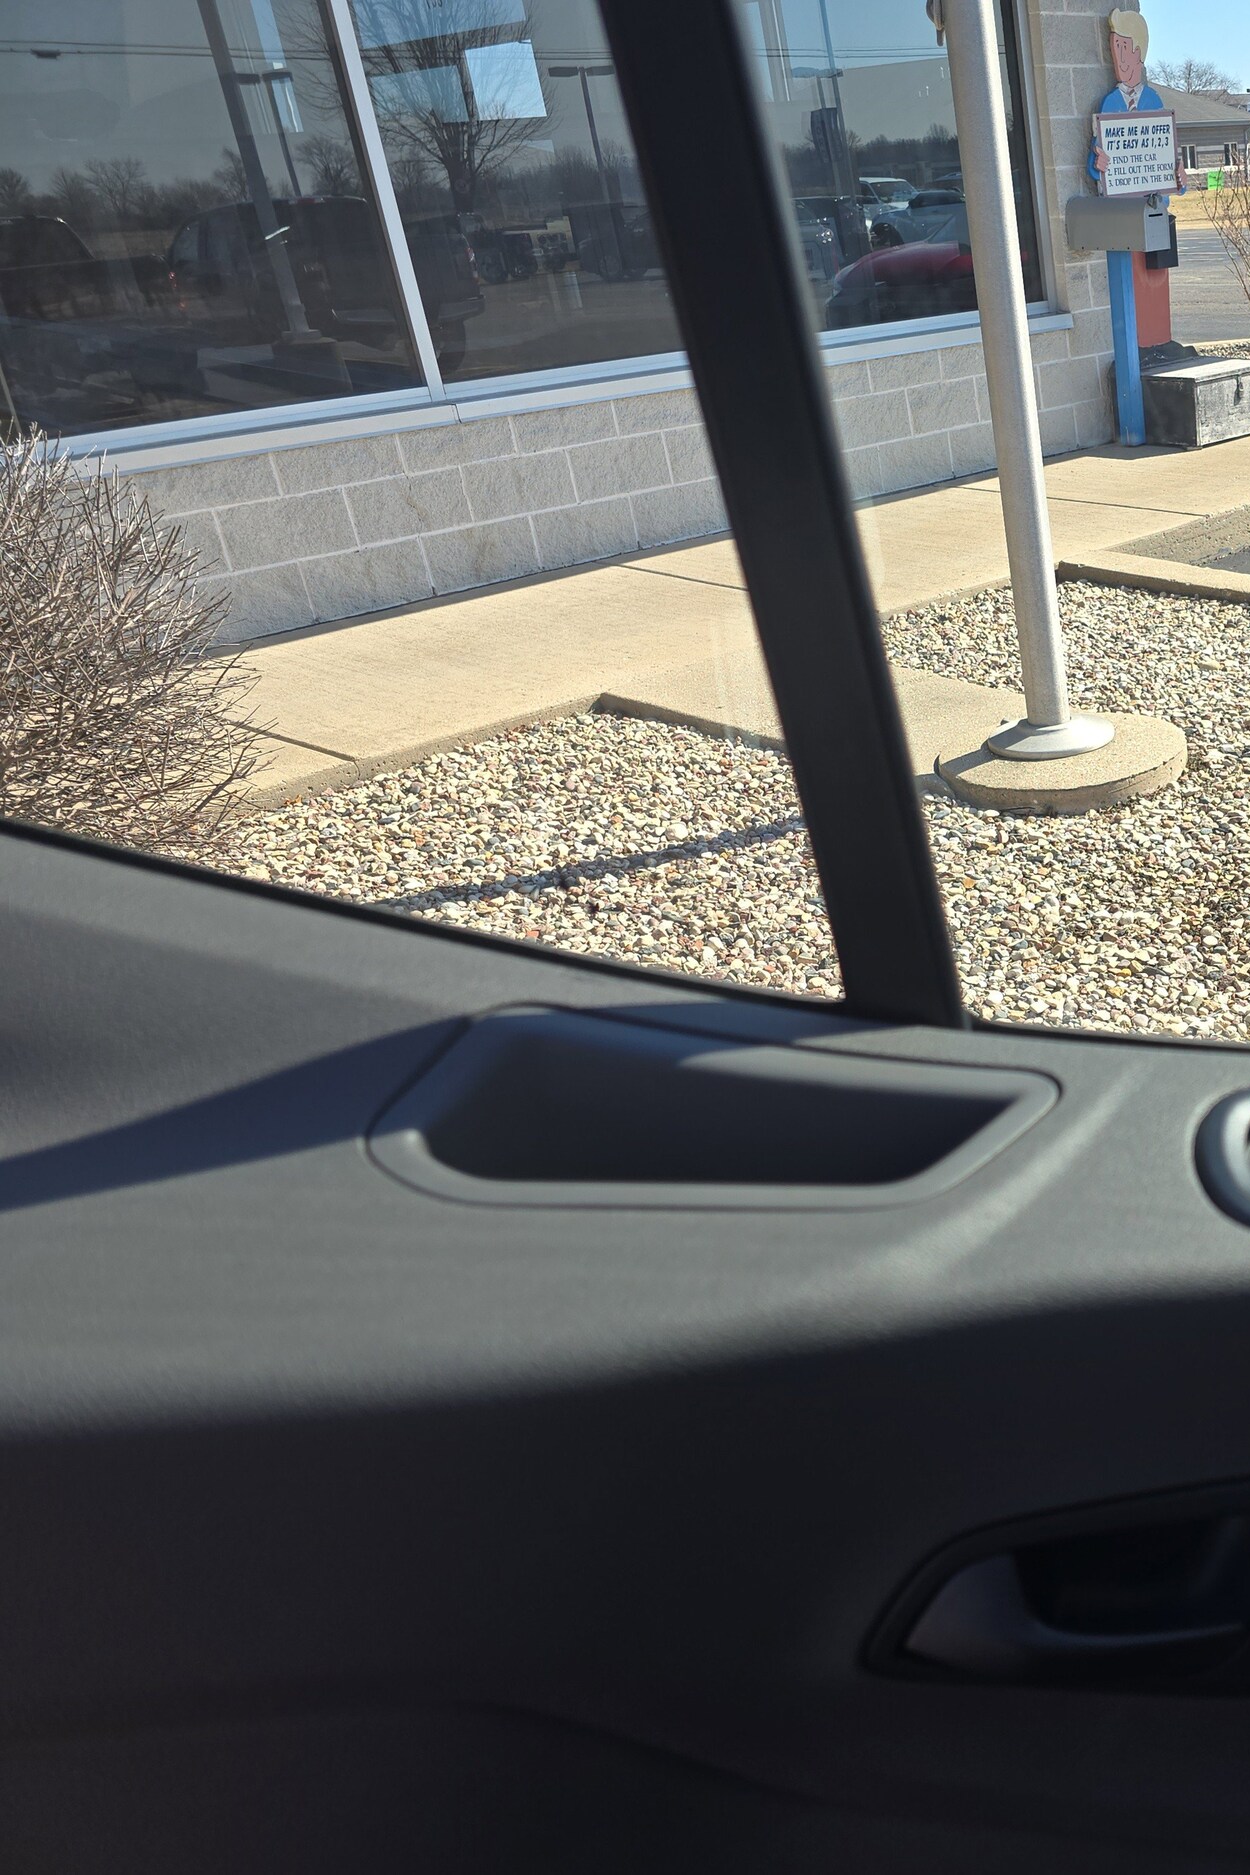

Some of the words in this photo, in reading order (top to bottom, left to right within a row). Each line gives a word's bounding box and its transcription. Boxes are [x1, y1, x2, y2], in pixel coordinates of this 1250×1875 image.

[1105, 127, 1125, 138] MAKE
[1128, 126, 1138, 136] ME
[1140, 126, 1149, 135] AN
[1152, 124, 1171, 135] OFFER
[1107, 140, 1120, 151] IT'S
[1123, 139, 1139, 150] EASY
[1141, 138, 1149, 148] AS
[1113, 156, 1128, 164] FIND
[1130, 155, 1143, 163] THE
[1144, 154, 1157, 162] CAR
[1114, 167, 1127, 176] FILL
[1128, 166, 1141, 174] OUT
[1143, 165, 1156, 173] THE
[1157, 163, 1174, 171] FORM
[1115, 178, 1132, 187] DROP
[1150, 175, 1162, 183] THE
[1163, 174, 1175, 182] BOX
